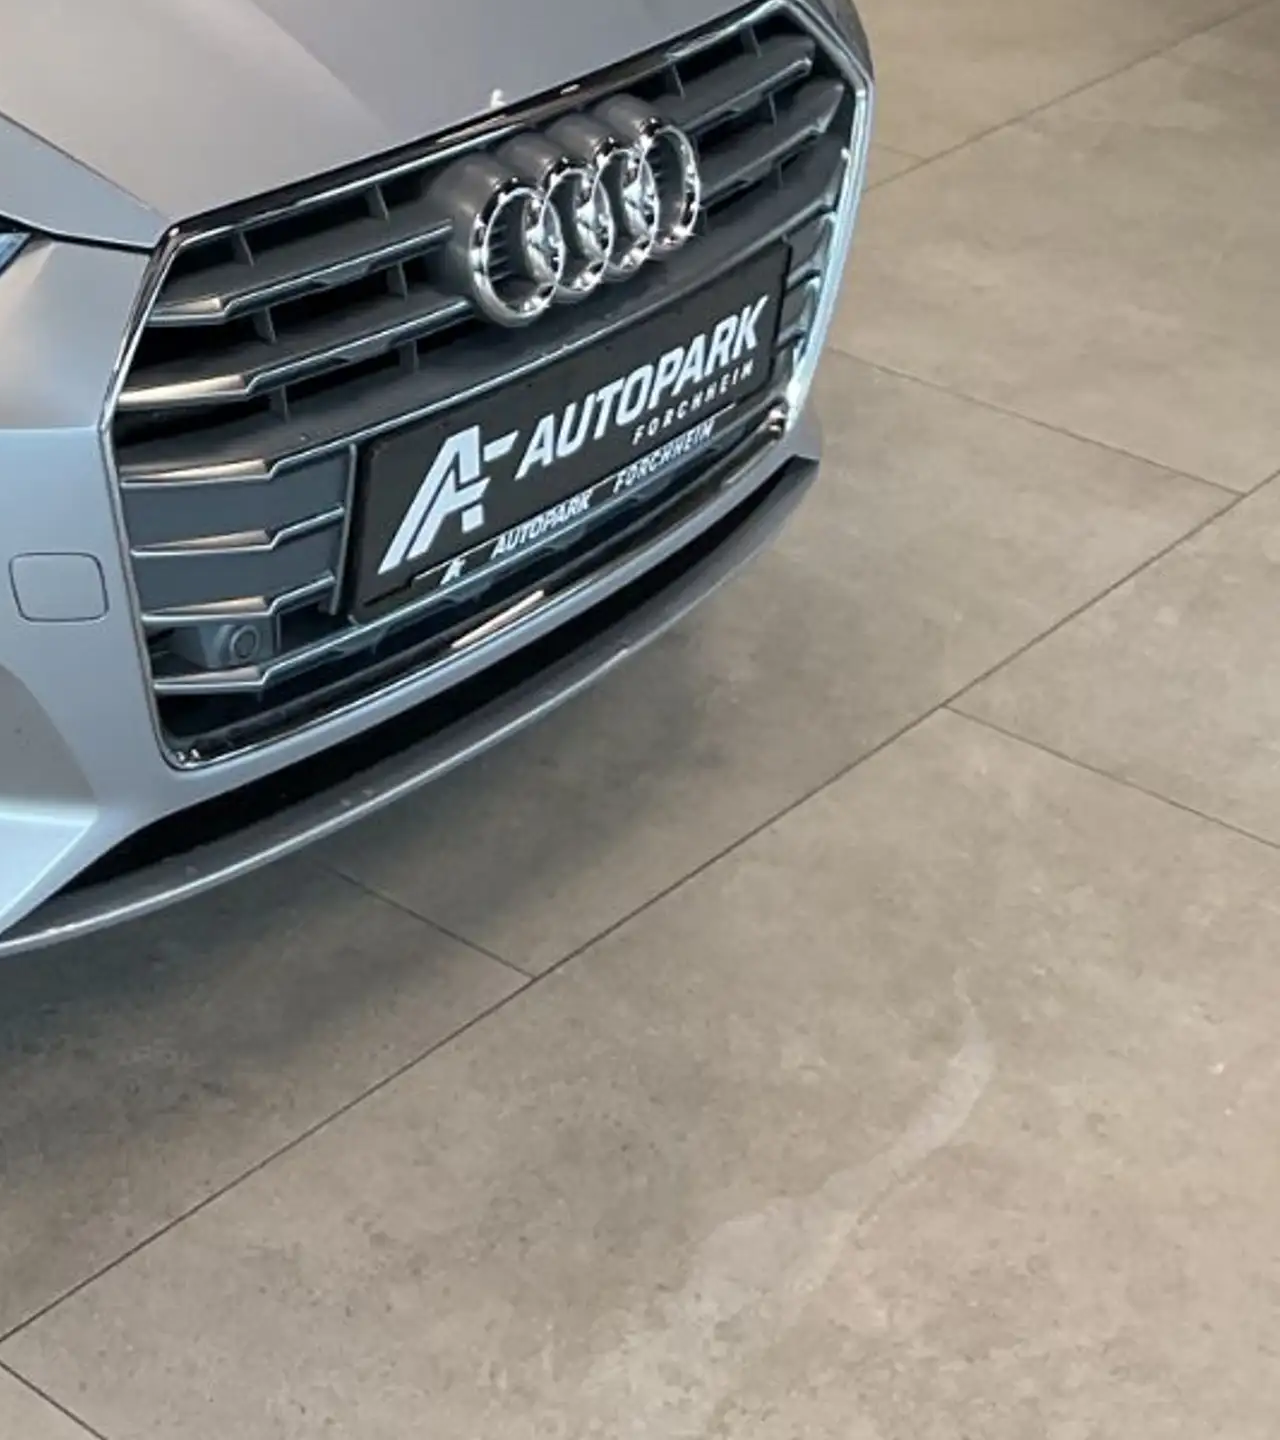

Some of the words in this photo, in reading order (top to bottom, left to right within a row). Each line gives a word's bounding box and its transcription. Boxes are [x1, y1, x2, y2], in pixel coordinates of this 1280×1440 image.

[514, 294, 770, 481] AUTOPARK
[632, 359, 755, 446] FORCHHEIM
[490, 488, 597, 560] AUTOPARK
[612, 416, 716, 494] FORCHHEIM
